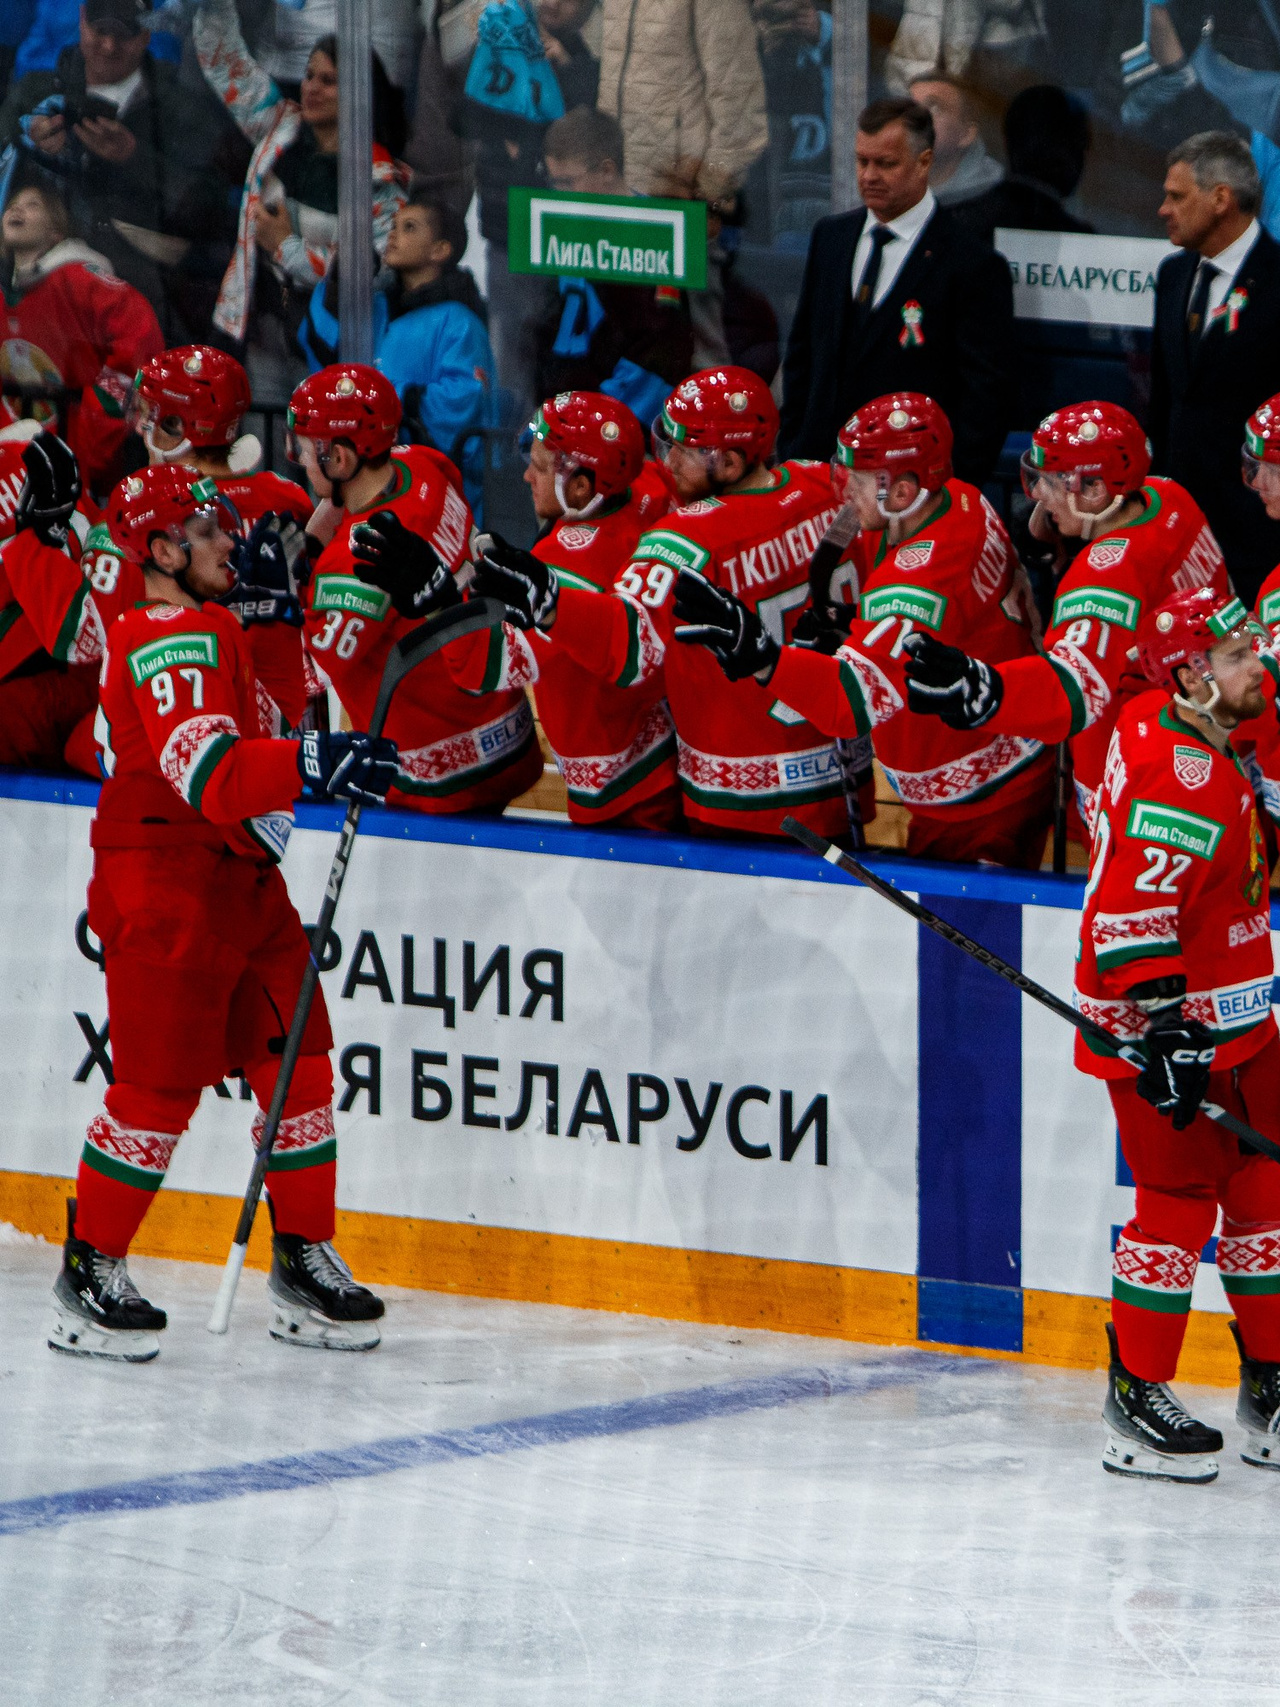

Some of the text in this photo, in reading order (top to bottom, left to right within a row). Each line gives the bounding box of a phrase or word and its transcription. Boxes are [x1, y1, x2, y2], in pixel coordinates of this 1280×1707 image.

[130, 508, 157, 528] CCM
[613, 561, 674, 607] 59
[311, 609, 366, 660] 36
[1063, 617, 1111, 660] 81
[1161, 649, 1187, 664] CCM
[150, 667, 205, 717] 97
[1133, 846, 1193, 895] 22
[410, 1047, 830, 1168] БЕЛАРУСИ
